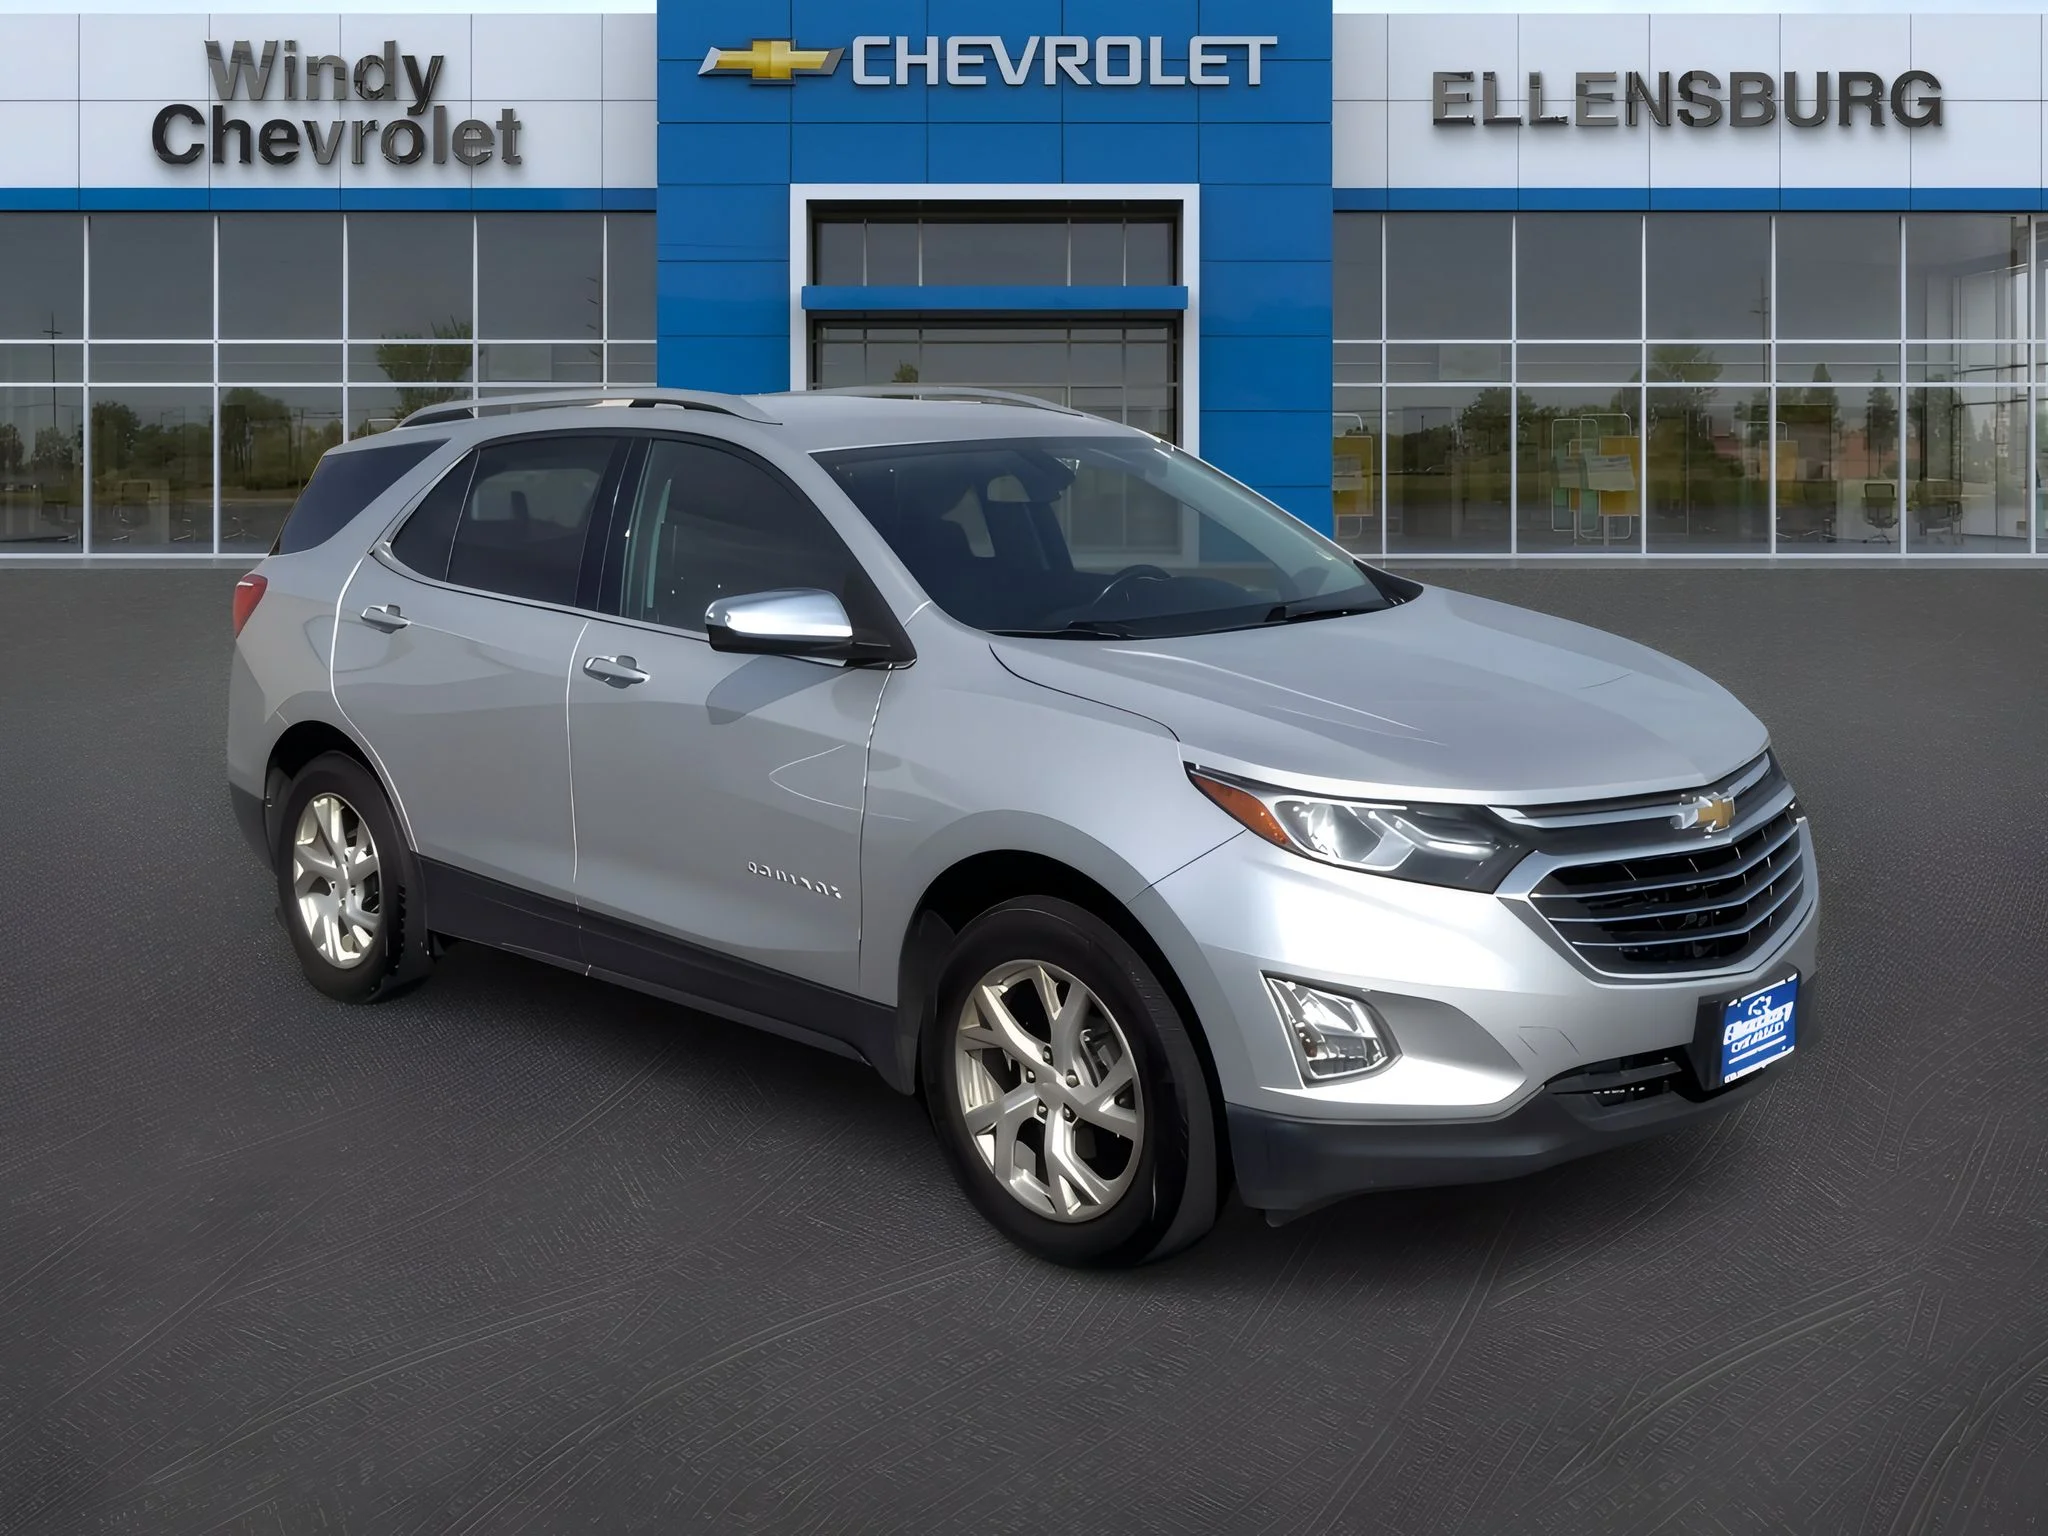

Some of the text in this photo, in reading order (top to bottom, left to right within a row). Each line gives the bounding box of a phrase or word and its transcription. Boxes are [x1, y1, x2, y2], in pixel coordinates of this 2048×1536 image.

[204, 40, 444, 115] Windy
[852, 36, 1278, 86] CHEVROLET
[1433, 70, 1943, 127] ELLENSBURG
[151, 104, 522, 165] Chevrolet
